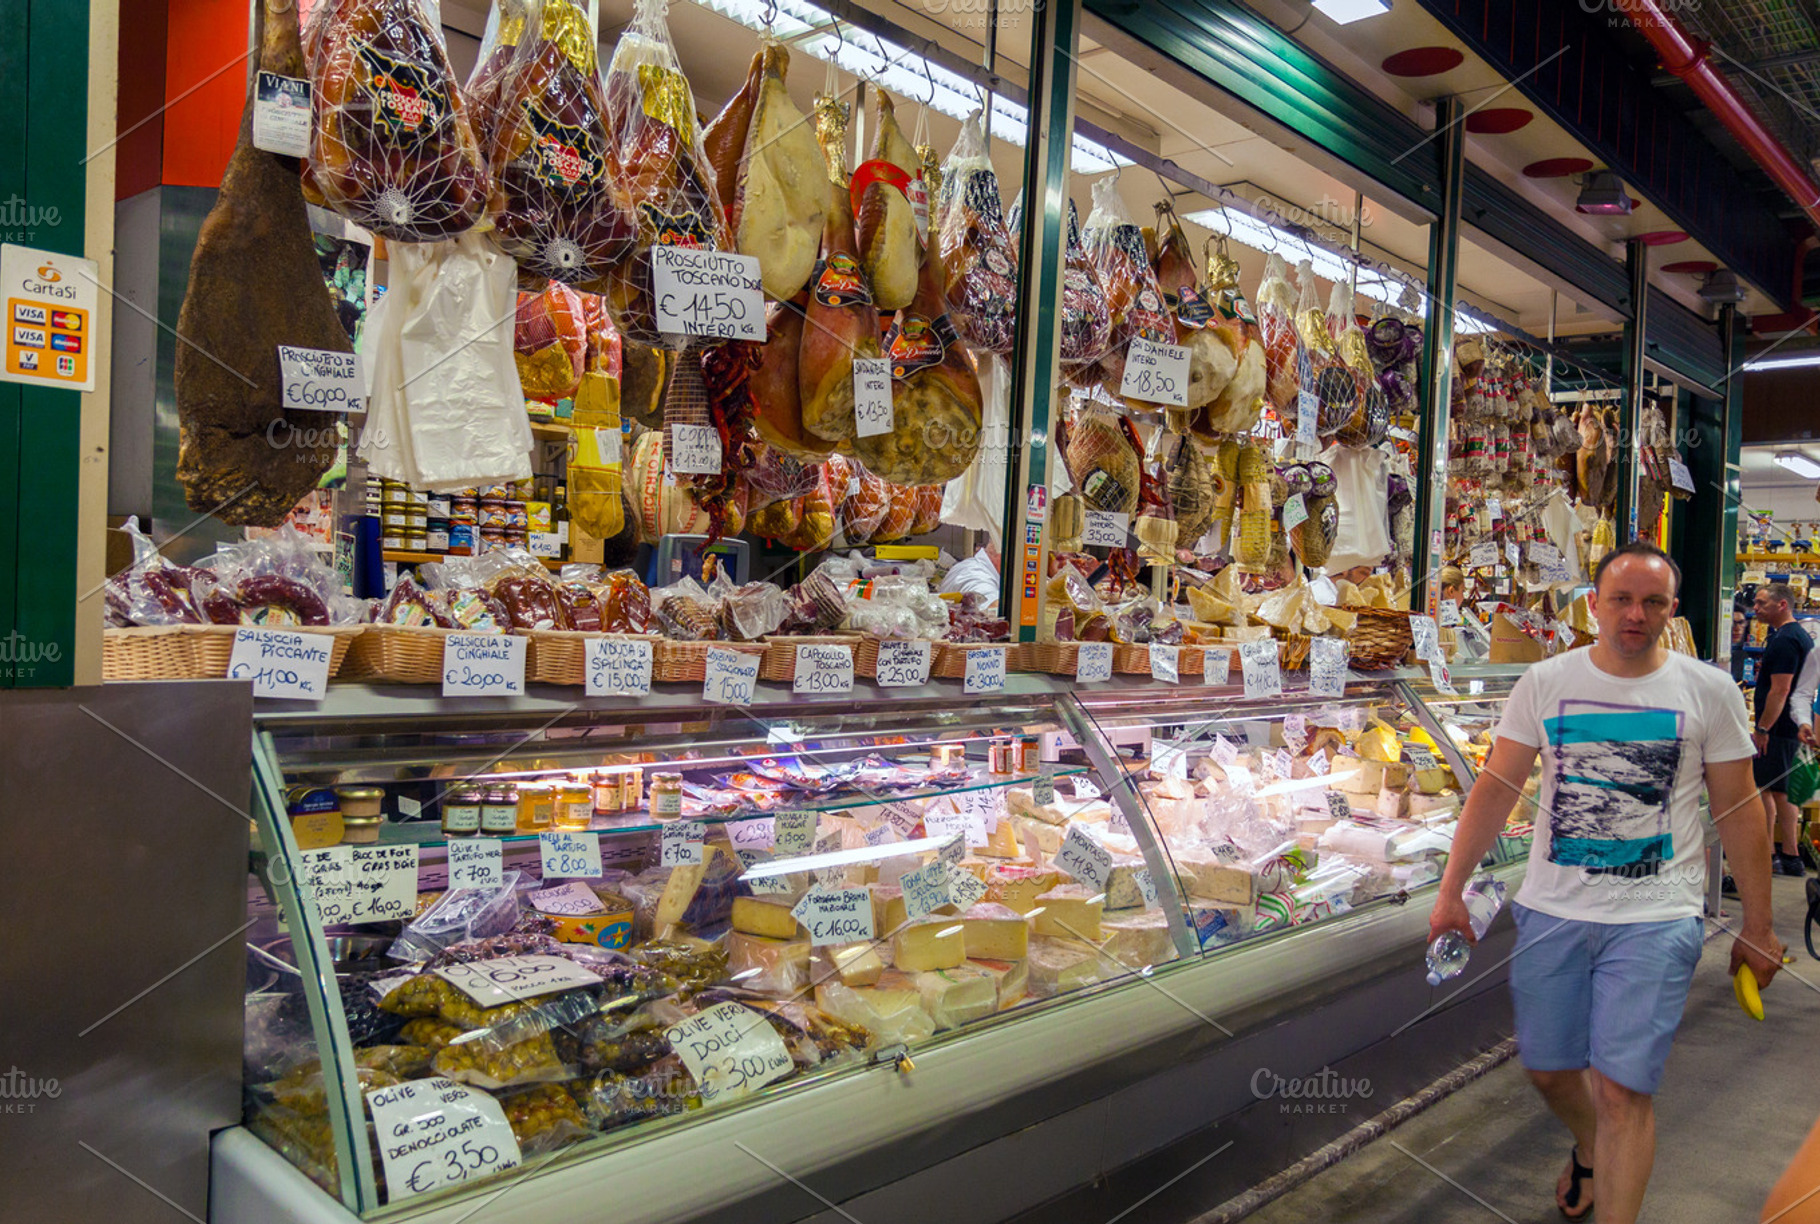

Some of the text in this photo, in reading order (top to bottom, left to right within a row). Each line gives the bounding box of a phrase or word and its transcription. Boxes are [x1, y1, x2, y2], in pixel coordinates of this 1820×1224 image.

[265, 75, 305, 94] VIANI
[381, 98, 436, 119] TOSCANO
[656, 247, 744, 274] PROSCIUTTO
[671, 269, 740, 287] TOSCANO
[23, 279, 77, 299] CartaSi
[19, 307, 45, 319] VISA
[659, 293, 746, 323] € 14,50
[18, 331, 44, 342] VISA
[683, 320, 735, 337] INTERO
[282, 347, 343, 366] PROSCIUTTO
[301, 363, 355, 378] CINGHIALE
[1133, 370, 1175, 396] 18,50
[238, 630, 303, 645] SALSICCIA
[447, 635, 513, 648] SALSICCIA DI
[260, 643, 328, 662] PICCANTE
[456, 647, 510, 660] CINGHIALE
[800, 647, 845, 660] CAPOCOLLO
[592, 658, 644, 670] SPILINGA
[814, 660, 850, 669] TOSCANO
[252, 667, 298, 689] 11,00
[445, 669, 458, 685] €
[460, 666, 504, 689] 20,00
[592, 673, 641, 692] € 15,00
[794, 672, 840, 692] € 13,00
[878, 667, 919, 684] € 25,00
[966, 675, 974, 686] €
[353, 850, 373, 860] BLOC
[551, 842, 588, 852] TARTUFO
[1062, 850, 1073, 861] €
[1070, 832, 1109, 867] MONTASIO
[362, 861, 390, 872] GRAS
[546, 854, 587, 874] € 8,00
[454, 868, 463, 879] €
[353, 902, 364, 916] €
[813, 921, 824, 938] €
[666, 1016, 713, 1043] OLIVE
[690, 1024, 743, 1061] DOLCI
[373, 1086, 416, 1107] OLIVE
[387, 1116, 483, 1160] DENOCCIOLATE
[405, 1140, 498, 1193] € 3,50
